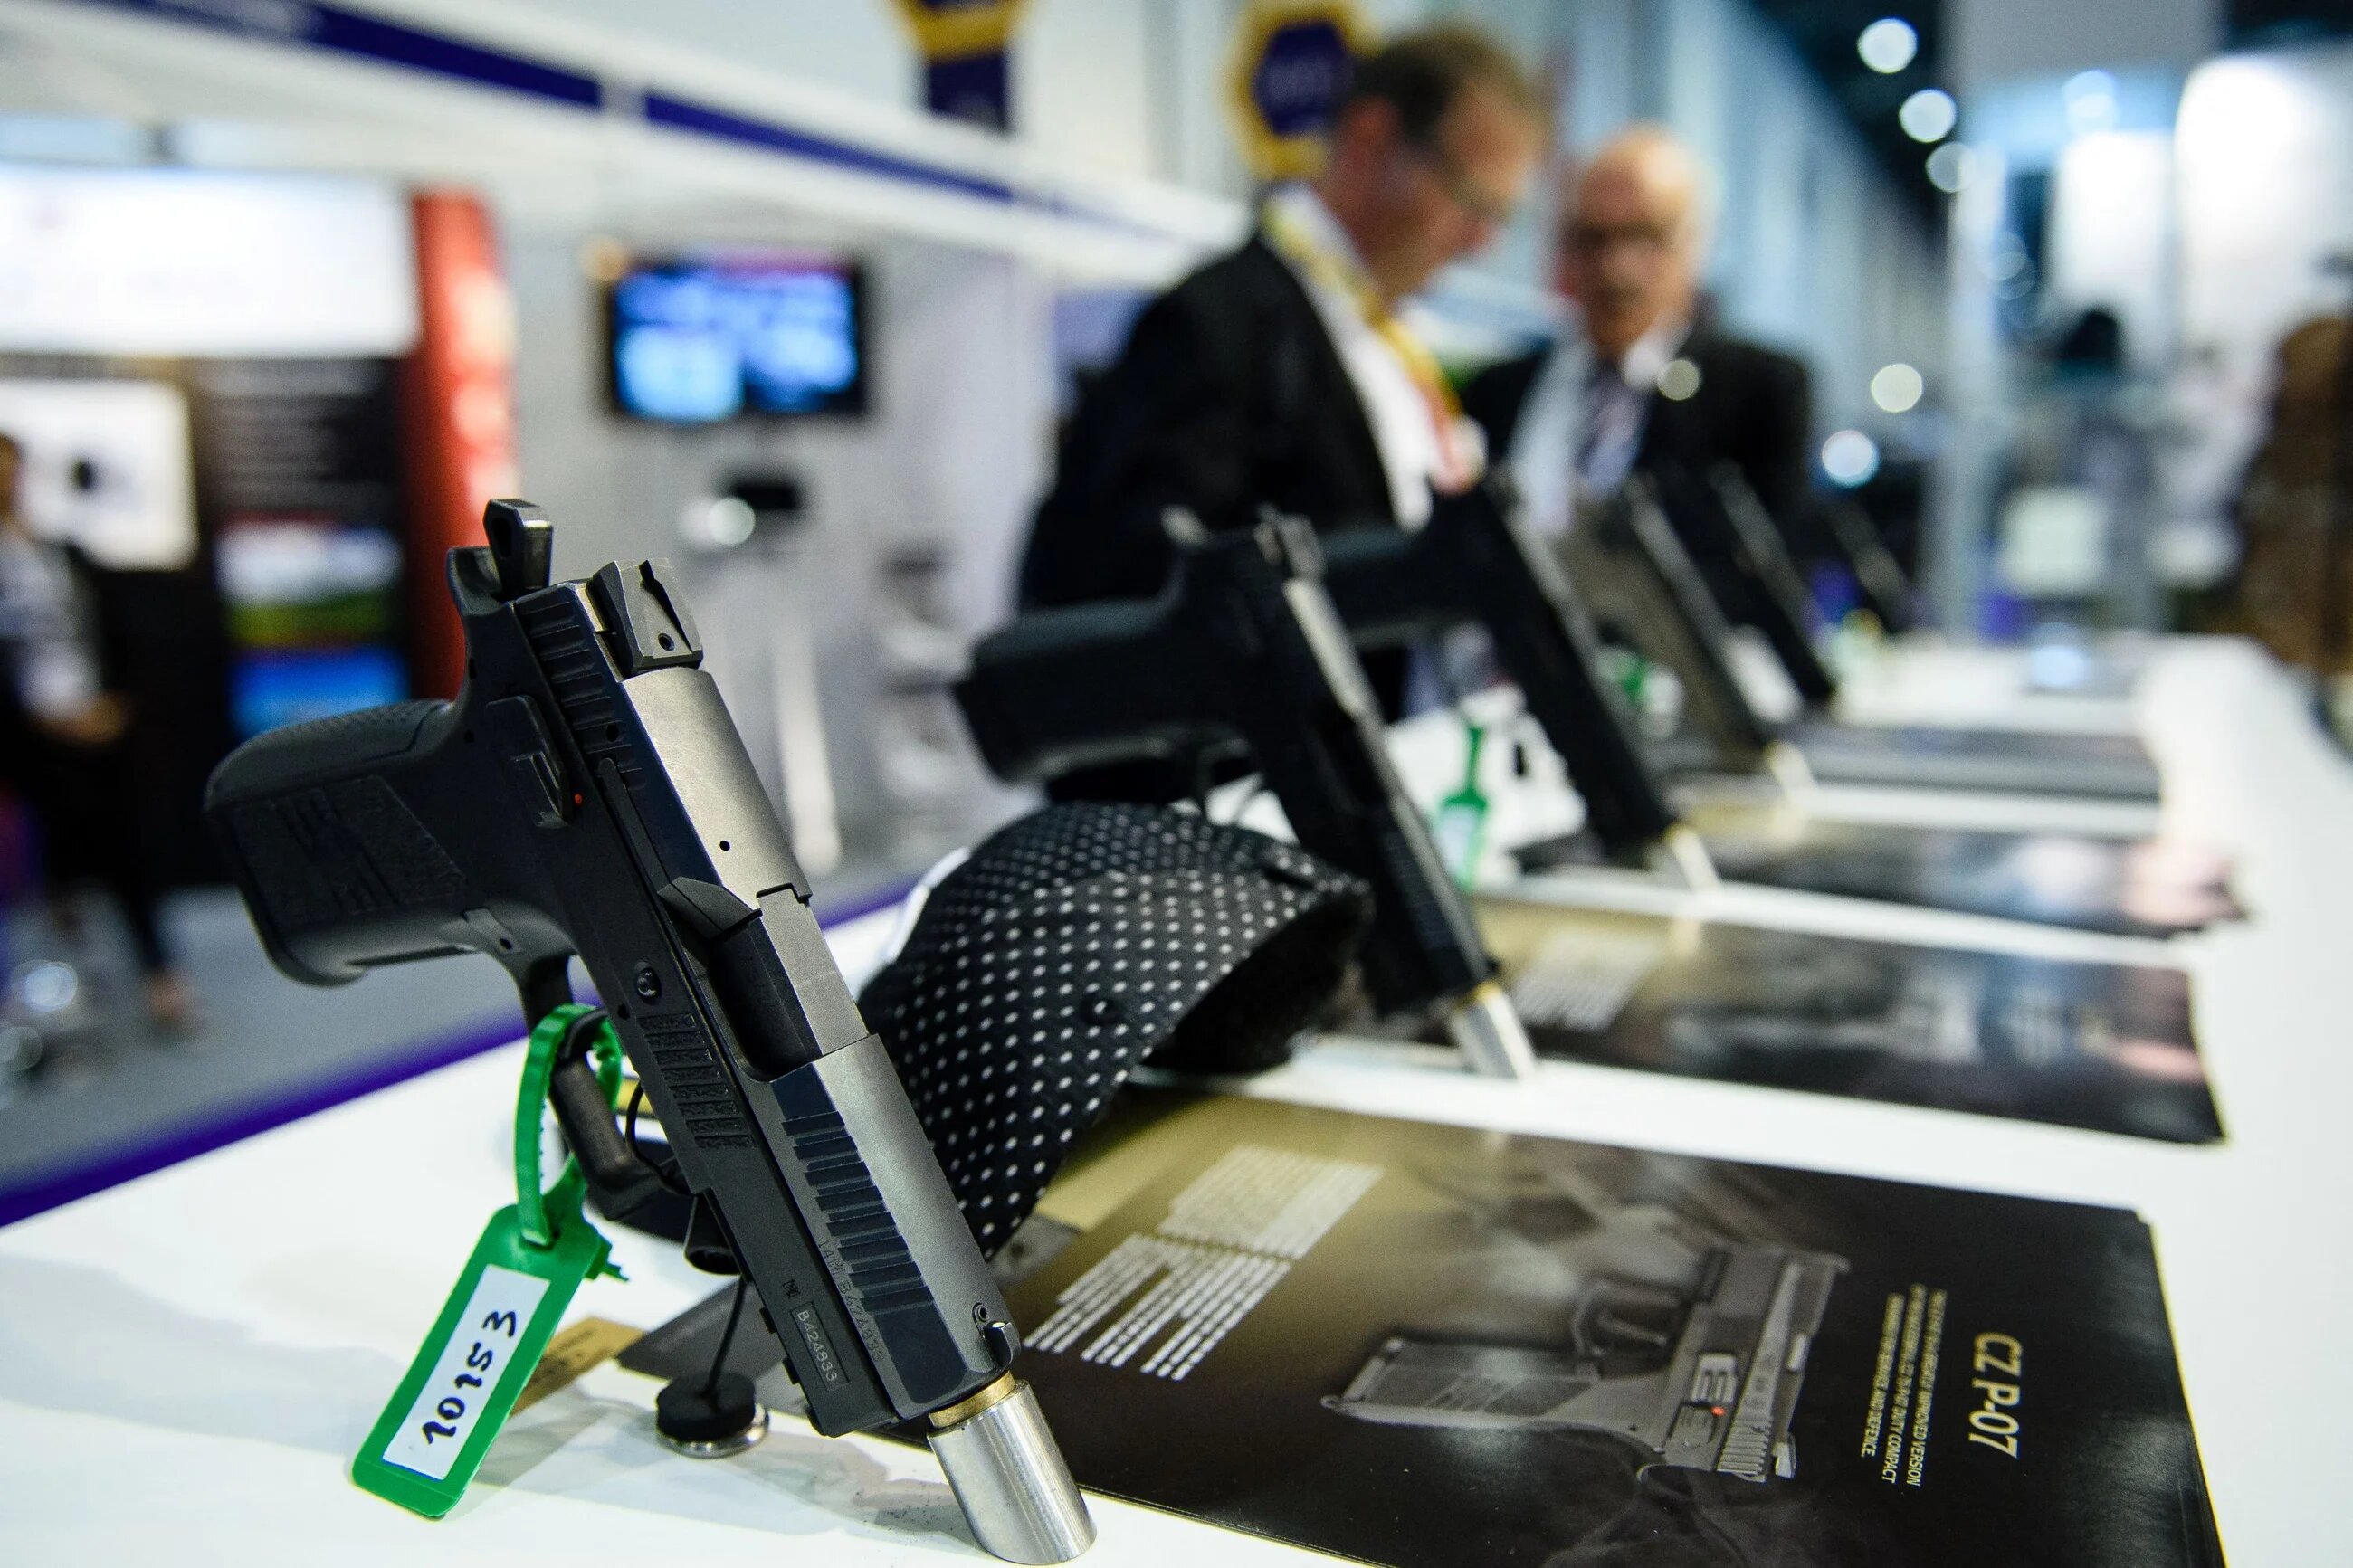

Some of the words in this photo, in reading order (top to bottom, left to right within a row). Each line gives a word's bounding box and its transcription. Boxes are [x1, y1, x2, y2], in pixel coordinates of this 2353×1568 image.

[797, 1310, 838, 1382] B424833
[1973, 1331, 2024, 1377] CZ
[423, 1310, 517, 1444] 10153
[1861, 1410, 1883, 1458] DEFENCE.
[1912, 1390, 1932, 1440] IMPROVED
[1968, 1377, 2021, 1459] P-07
[1881, 1432, 1902, 1484] COMPACT
[1907, 1440, 1926, 1487] VERSION
